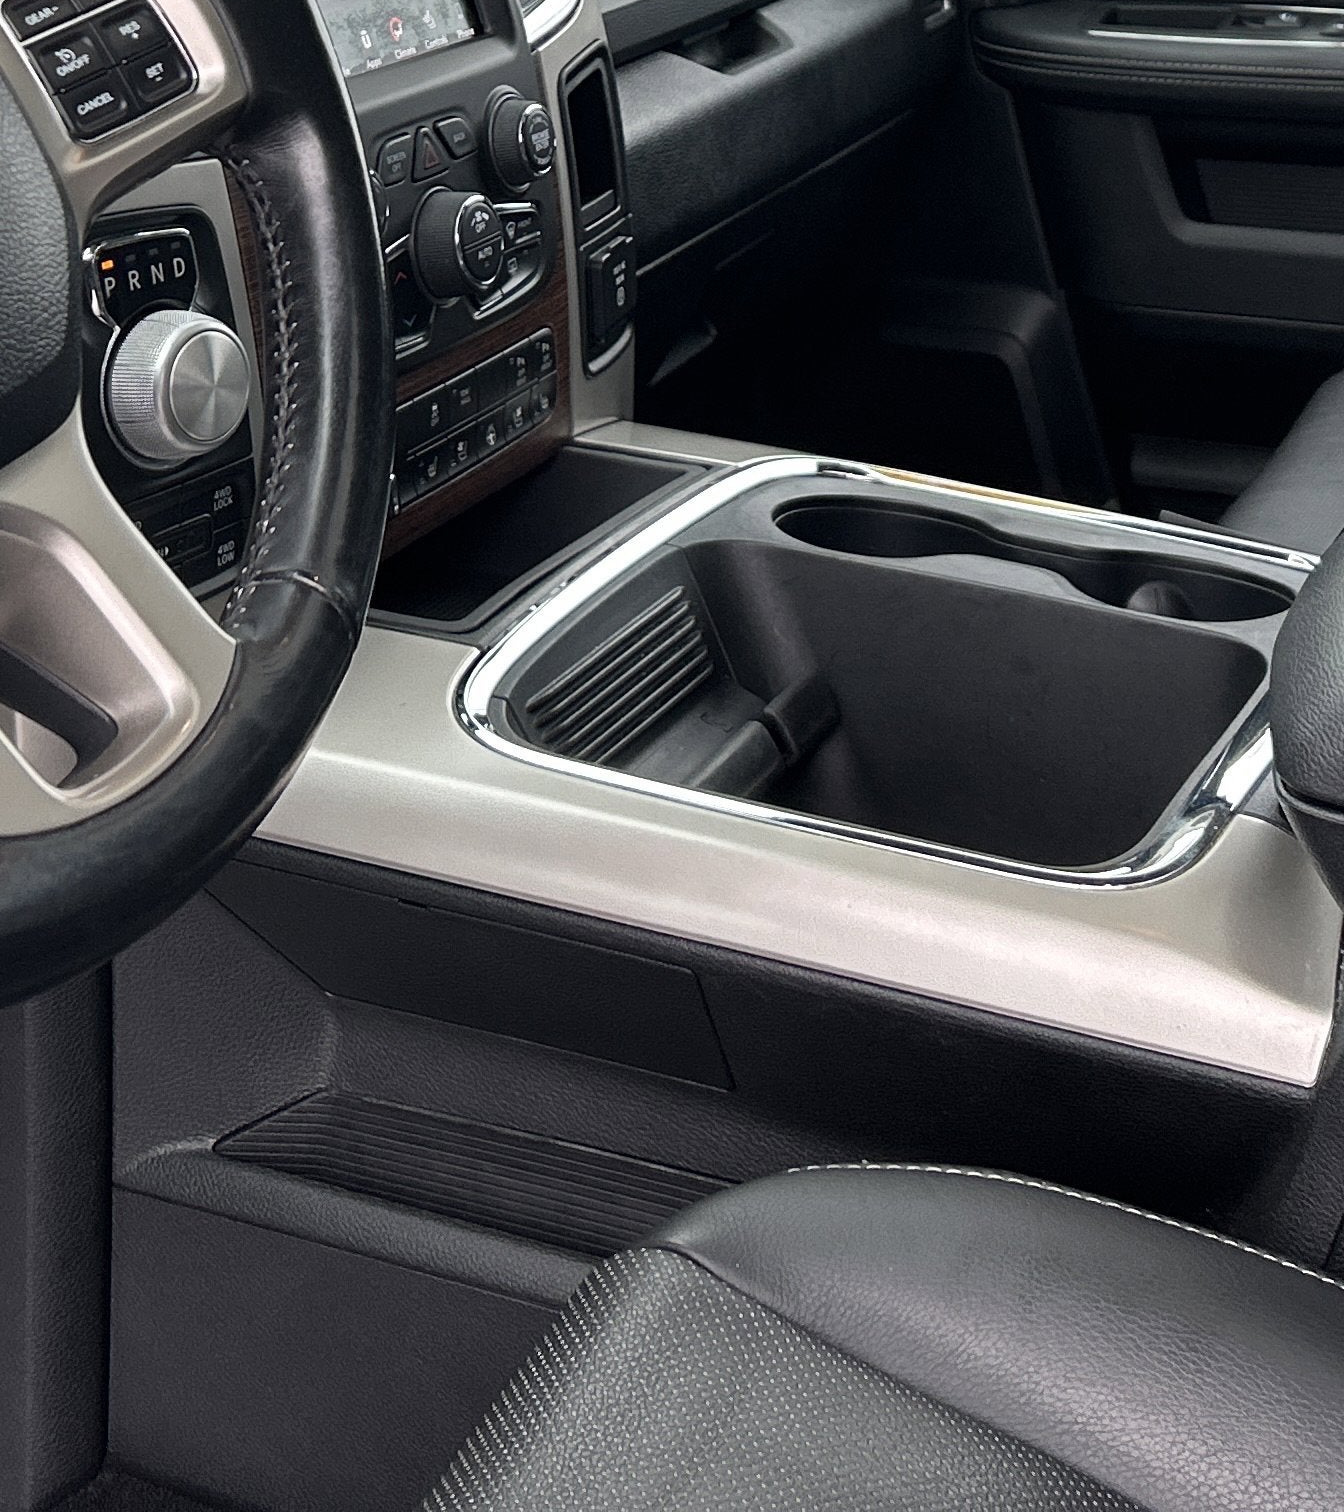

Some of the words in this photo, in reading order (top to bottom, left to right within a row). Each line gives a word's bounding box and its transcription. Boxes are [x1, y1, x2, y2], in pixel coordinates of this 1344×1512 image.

[77, 92, 115, 115] CANCEL
[104, 277, 116, 299] P
[128, 270, 141, 291] R
[150, 262, 165, 285] N
[173, 257, 186, 278] D
[214, 486, 232, 499] 4WD
[214, 496, 233, 511] LOCK
[218, 540, 235, 555] 4WD
[217, 550, 235, 567] LOW
